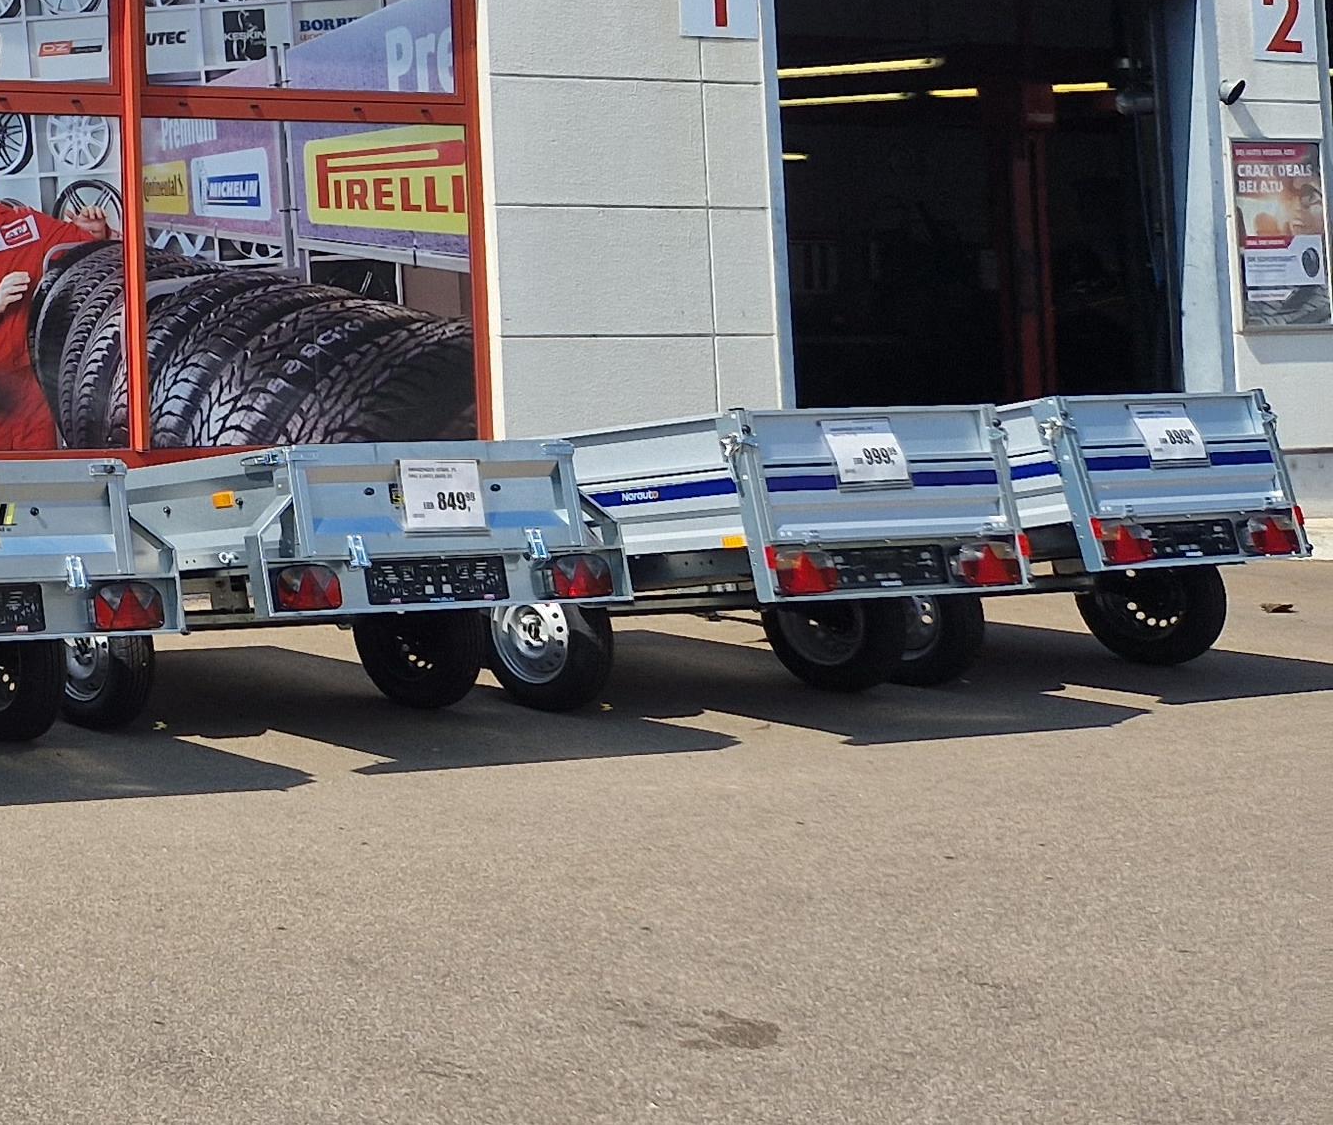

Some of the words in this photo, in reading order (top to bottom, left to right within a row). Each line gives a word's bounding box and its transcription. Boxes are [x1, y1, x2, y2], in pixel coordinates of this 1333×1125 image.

[224, 31, 266, 41] KESKIN
[1237, 164, 1275, 177] CRAZY
[1277, 164, 1313, 177] DEALS
[209, 179, 259, 198] MICHELIN
[1260, 180, 1284, 193] ATU
